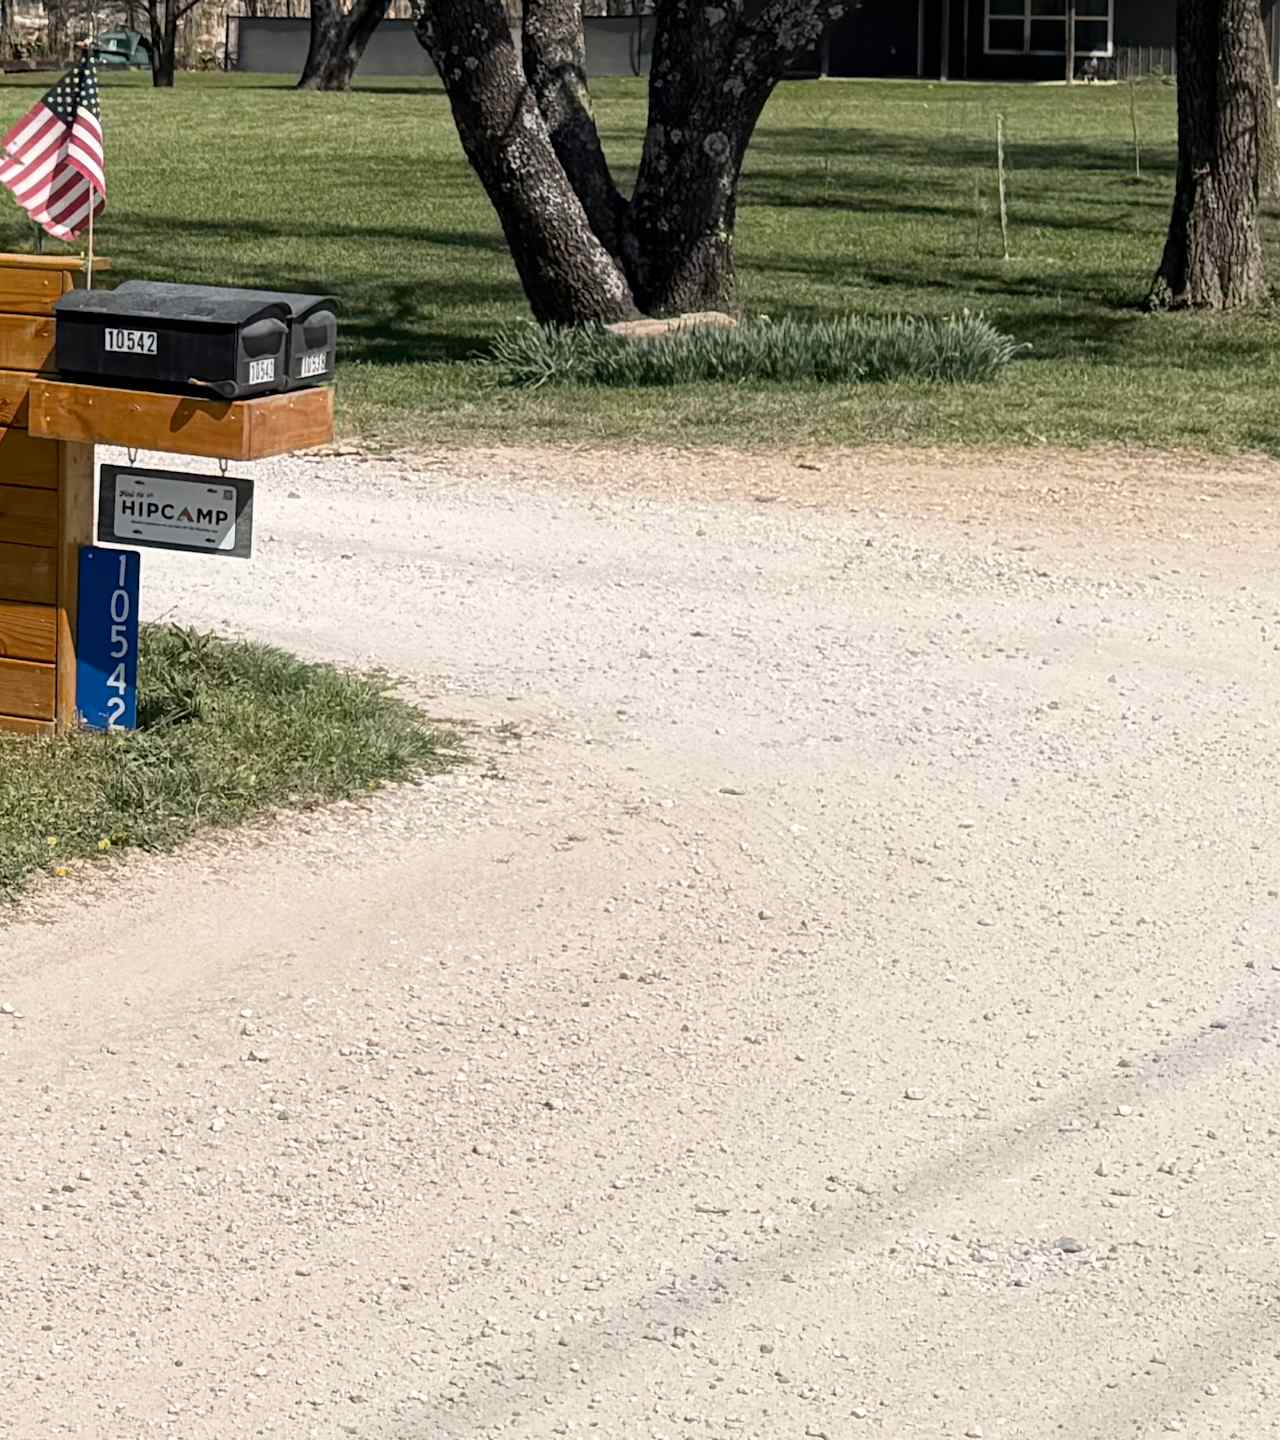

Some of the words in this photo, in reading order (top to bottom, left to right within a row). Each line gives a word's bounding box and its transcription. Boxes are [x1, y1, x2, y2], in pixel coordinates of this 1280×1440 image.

[108, 329, 155, 353] 10542
[121, 499, 228, 526] HIPCAMP
[105, 554, 131, 731] 10542
